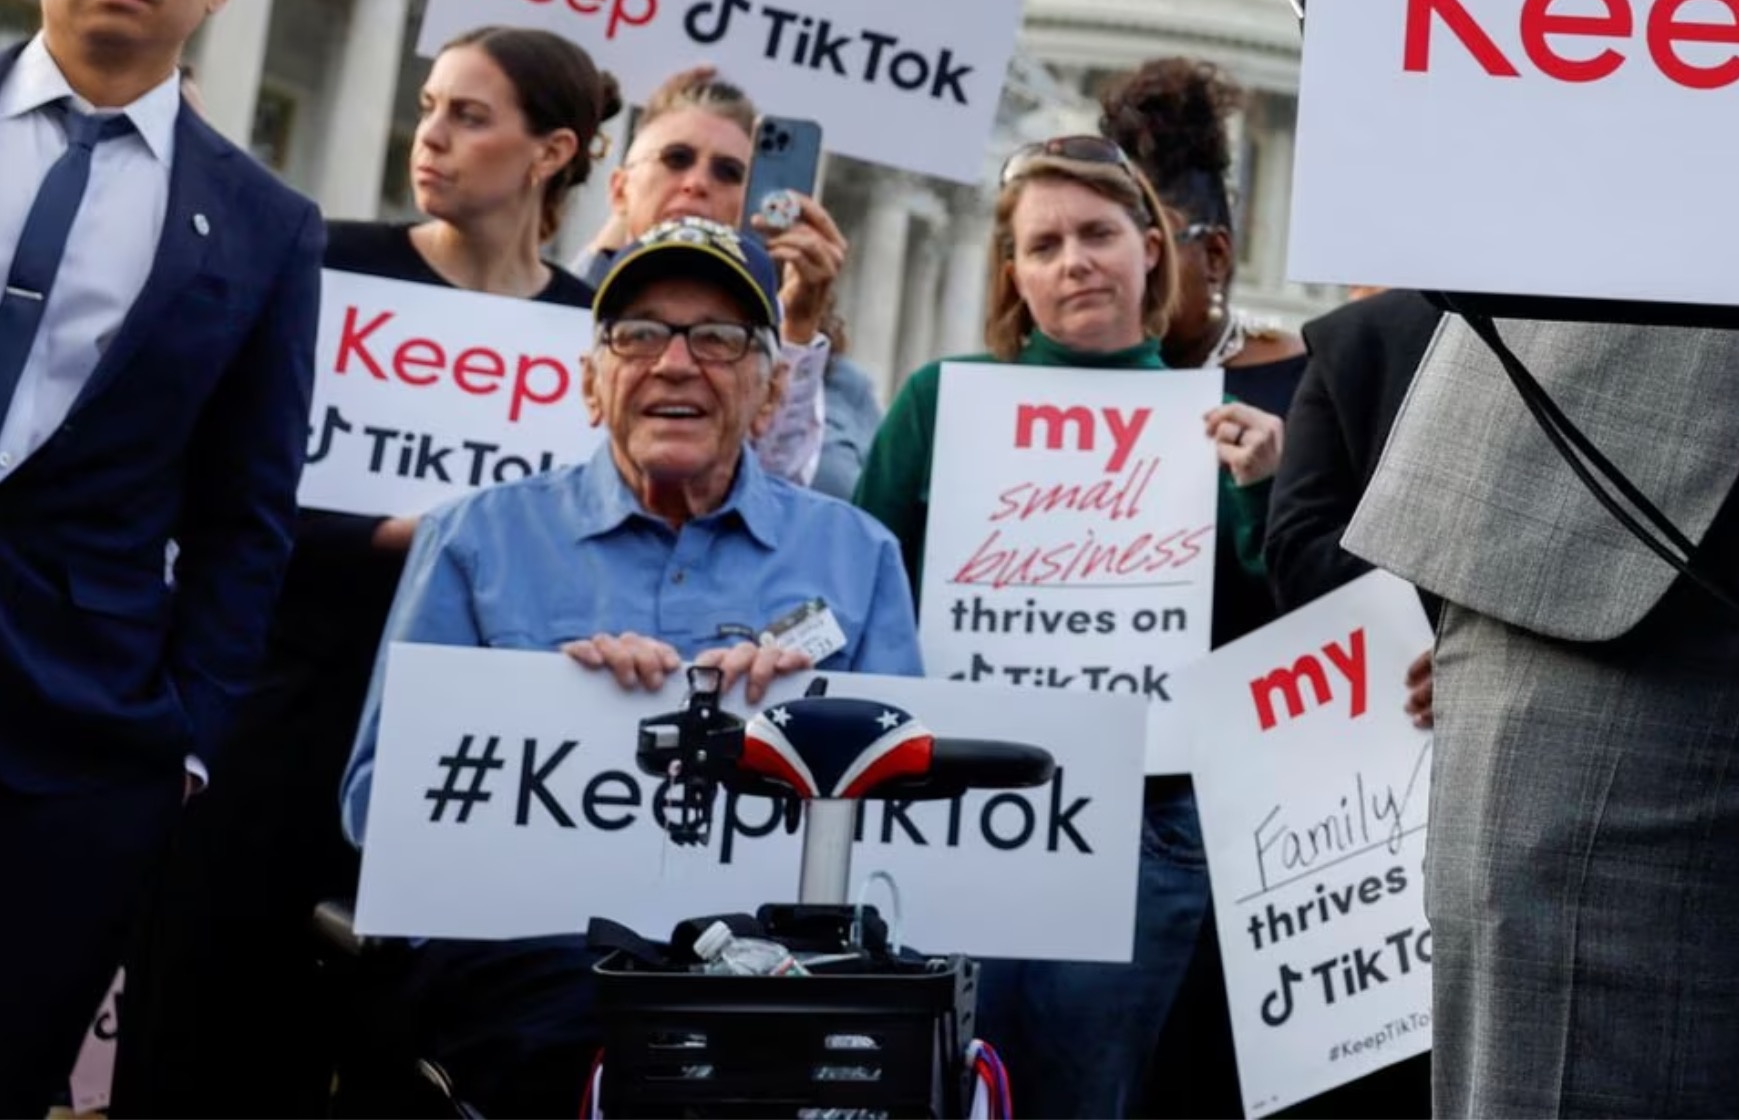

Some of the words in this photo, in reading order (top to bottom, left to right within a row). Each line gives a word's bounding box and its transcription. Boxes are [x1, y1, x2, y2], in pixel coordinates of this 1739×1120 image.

[761, 6, 973, 106] TikTok
[334, 306, 571, 422] Keep
[1013, 403, 1153, 473] my
[989, 457, 1160, 522] small
[953, 525, 1213, 590] business
[950, 596, 1116, 635] thrives
[1131, 606, 1187, 633] on
[1249, 627, 1368, 731] my
[1254, 742, 1431, 893] Family
[1247, 865, 1408, 950] thrives
